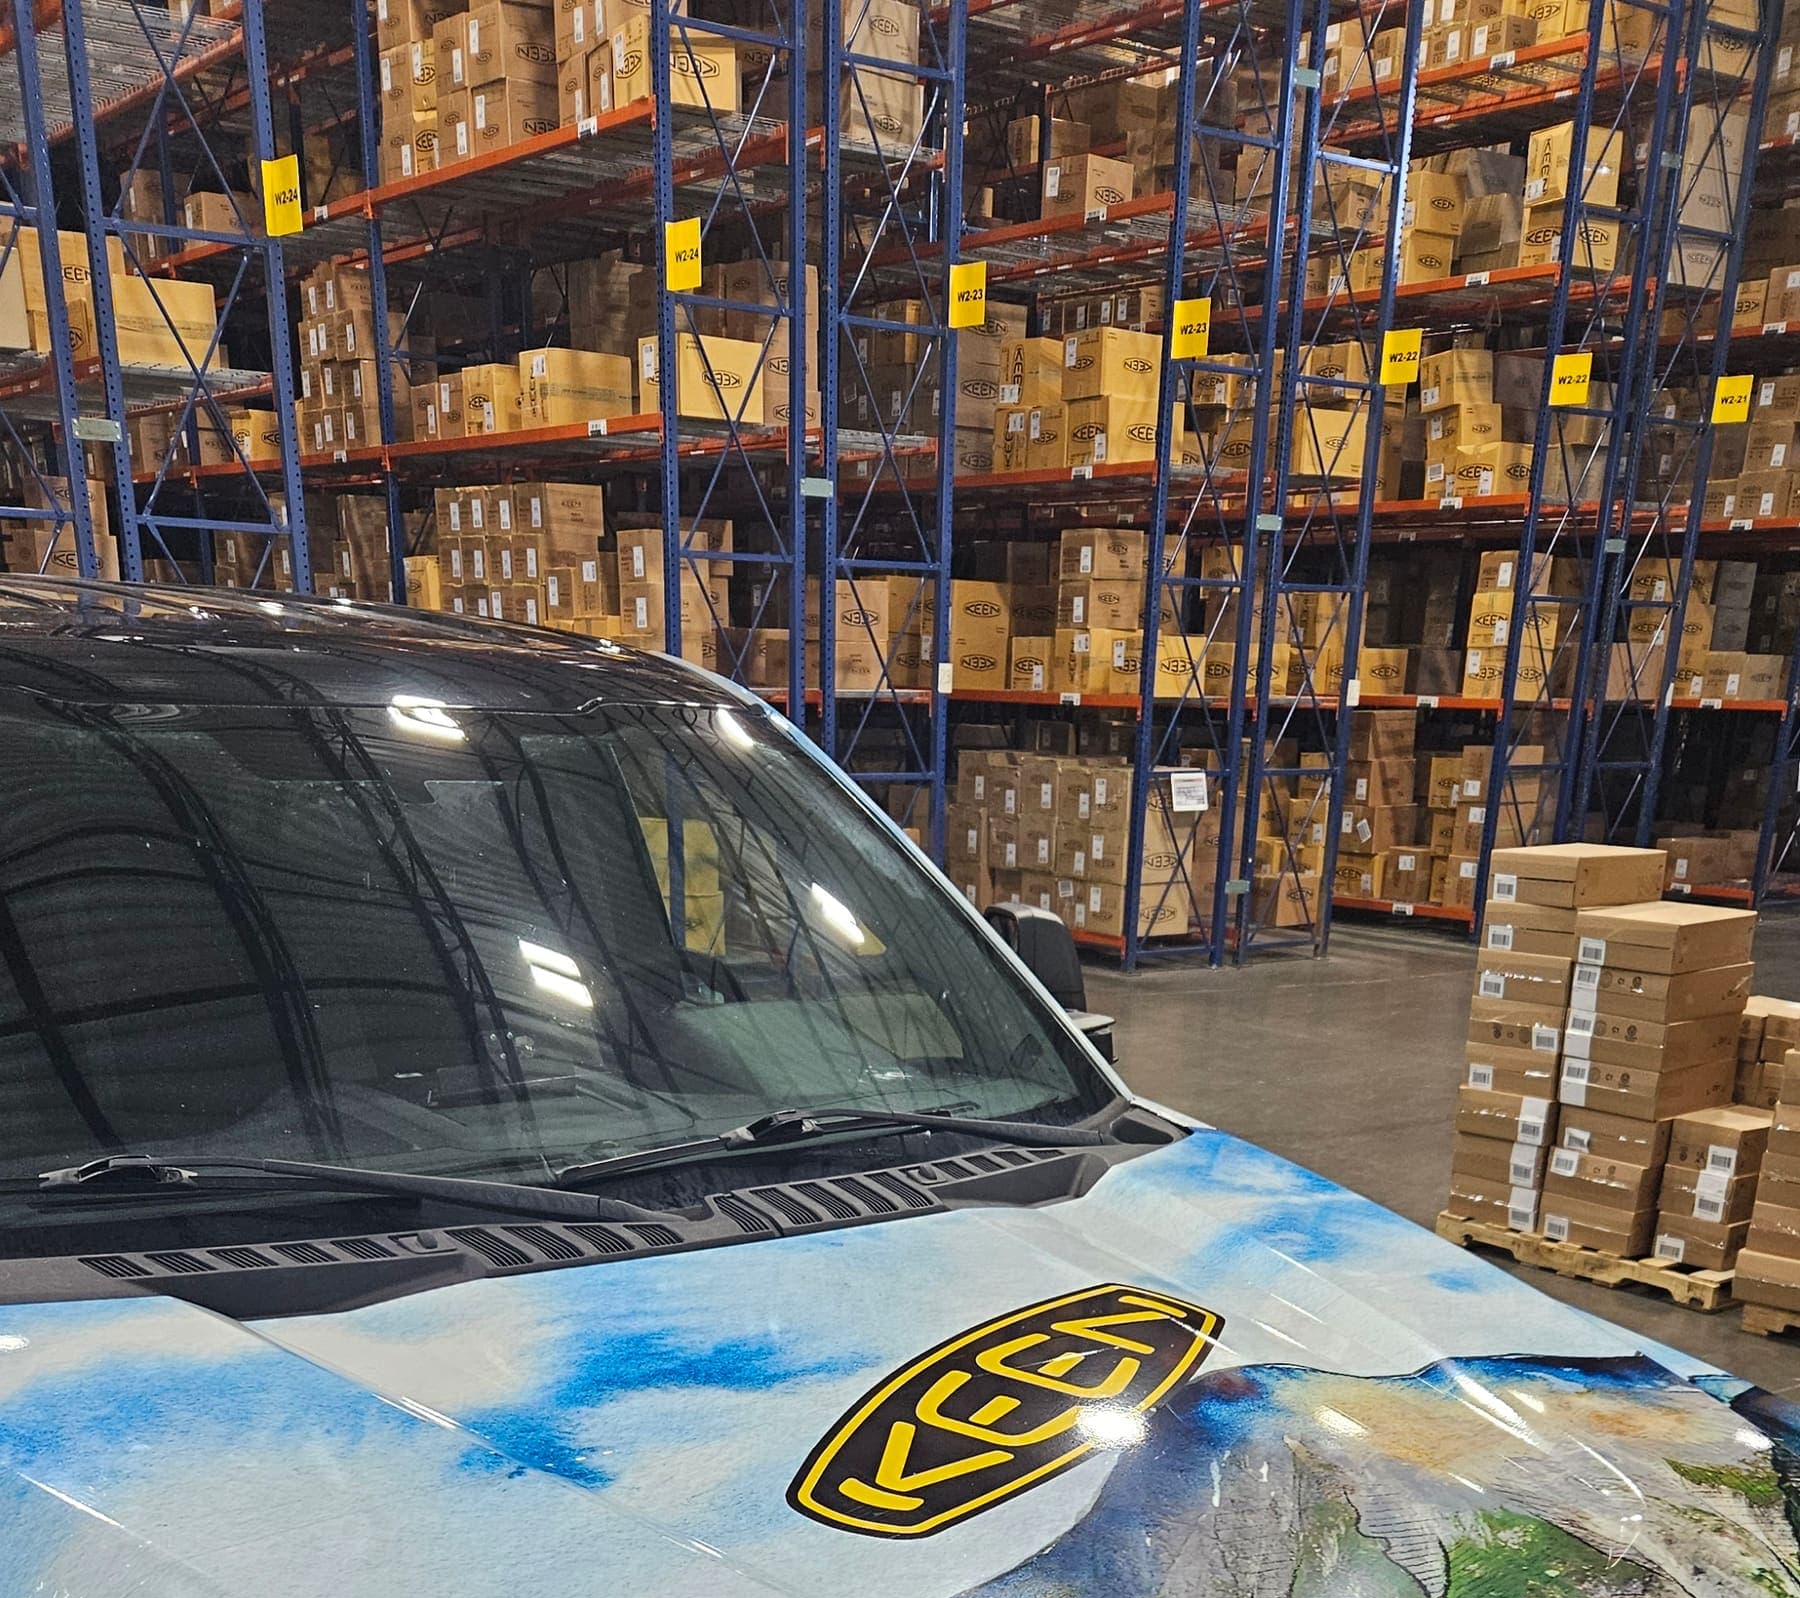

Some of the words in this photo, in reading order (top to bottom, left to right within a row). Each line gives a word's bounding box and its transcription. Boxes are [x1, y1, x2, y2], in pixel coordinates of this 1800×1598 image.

[274, 189, 298, 206] W2-24
[675, 248, 699, 263] W2-24
[957, 290, 983, 302] W2-23
[1180, 323, 1207, 335] W2-23
[1389, 352, 1418, 363] W2-22
[1558, 375, 1587, 385] W2-22
[1720, 395, 1747, 404] W2-21
[838, 1295, 1187, 1511] KEEN
